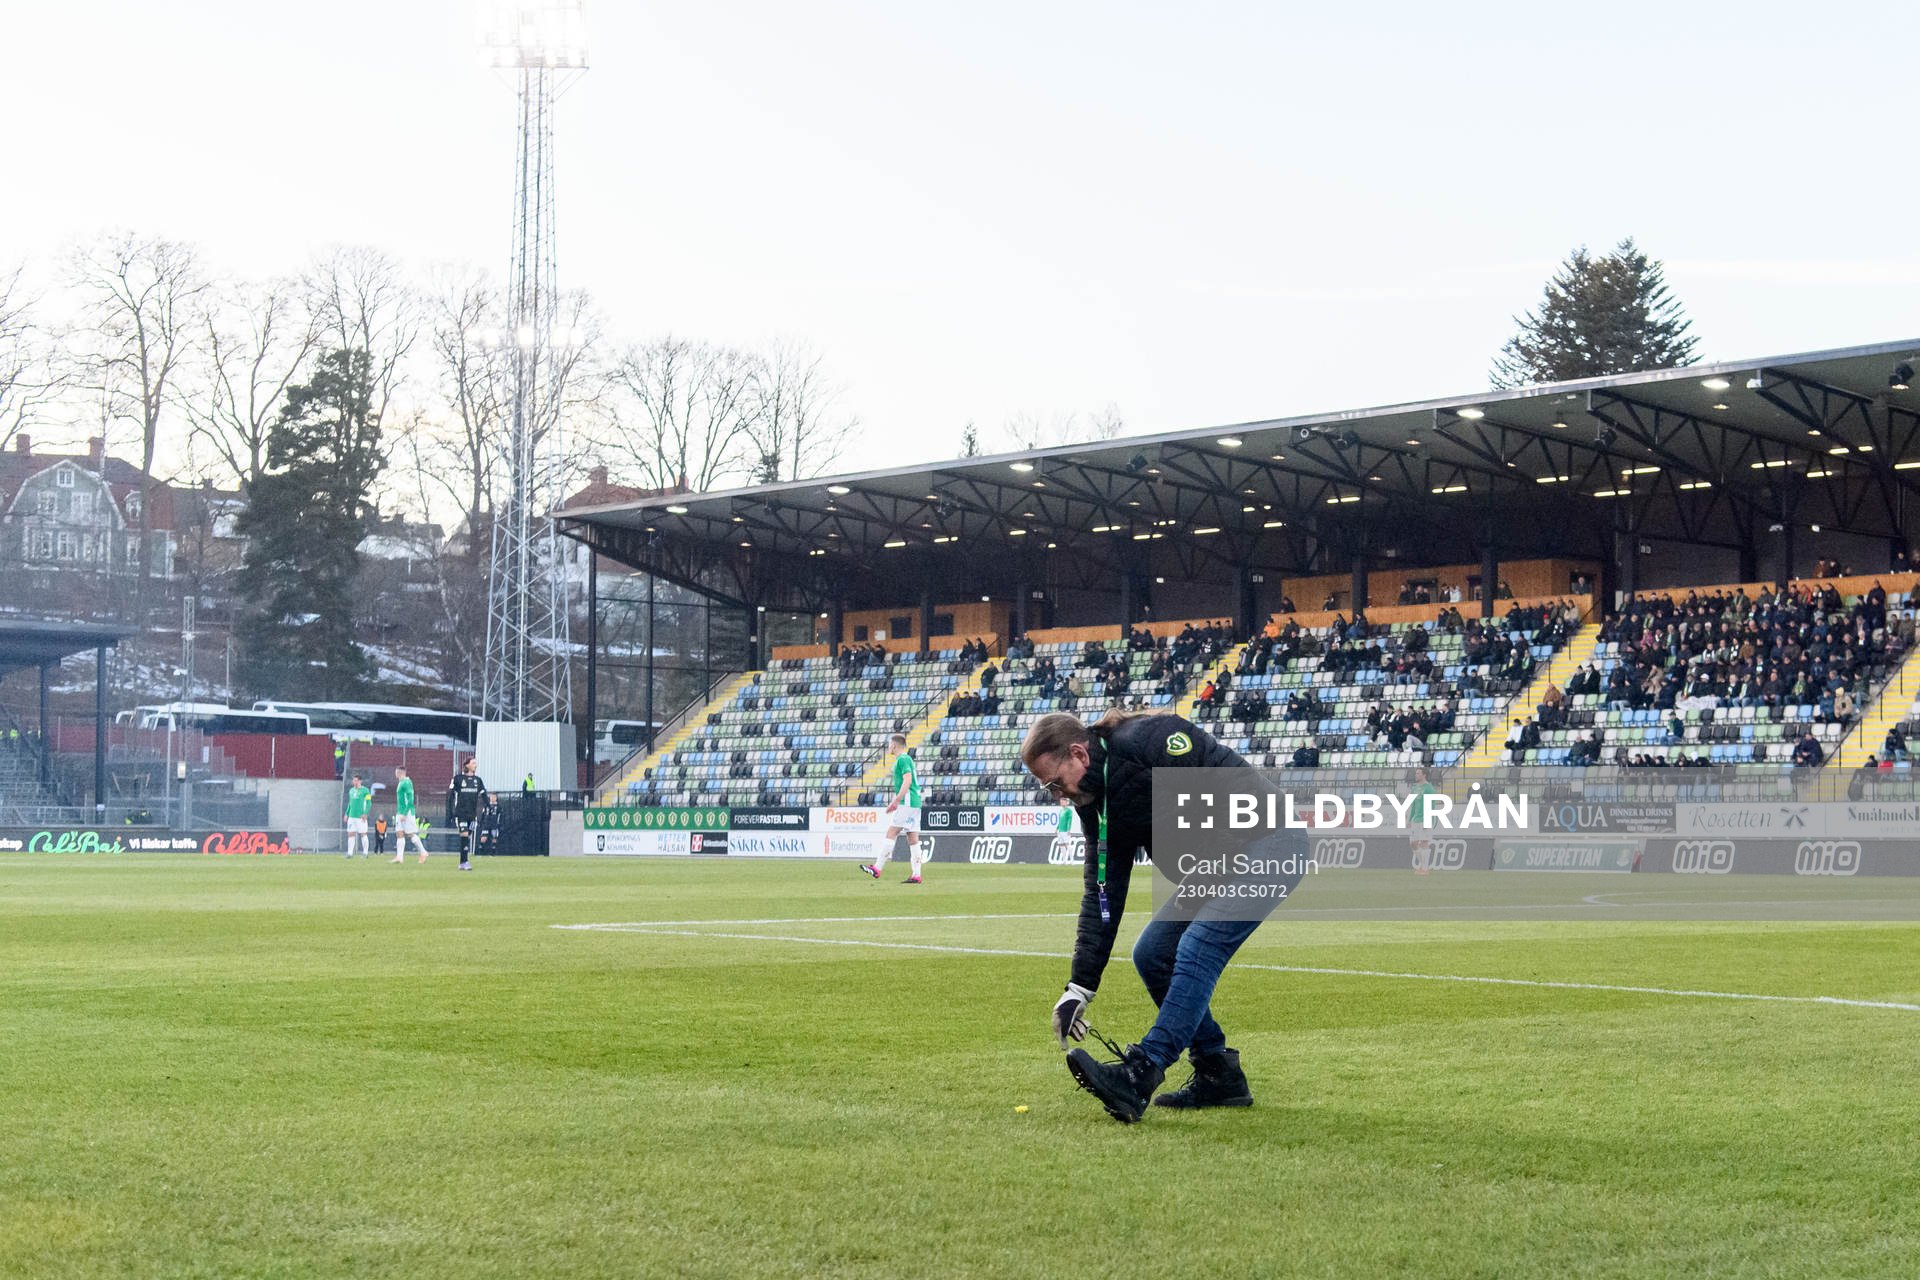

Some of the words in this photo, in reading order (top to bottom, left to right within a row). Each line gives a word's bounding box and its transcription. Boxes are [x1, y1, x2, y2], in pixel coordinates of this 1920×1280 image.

[826, 808, 877, 824] Passera
[1001, 812, 1058, 826] INTERSPO
[1544, 805, 1608, 832] AQUA
[1610, 808, 1638, 816] DINNER
[1646, 808, 1673, 817] DRINKS
[1689, 806, 1772, 832] Rosetten
[730, 835, 766, 852] SÄKRA
[769, 835, 806, 852] SÄKRA
[1526, 847, 1603, 867] SUPERETTAN
